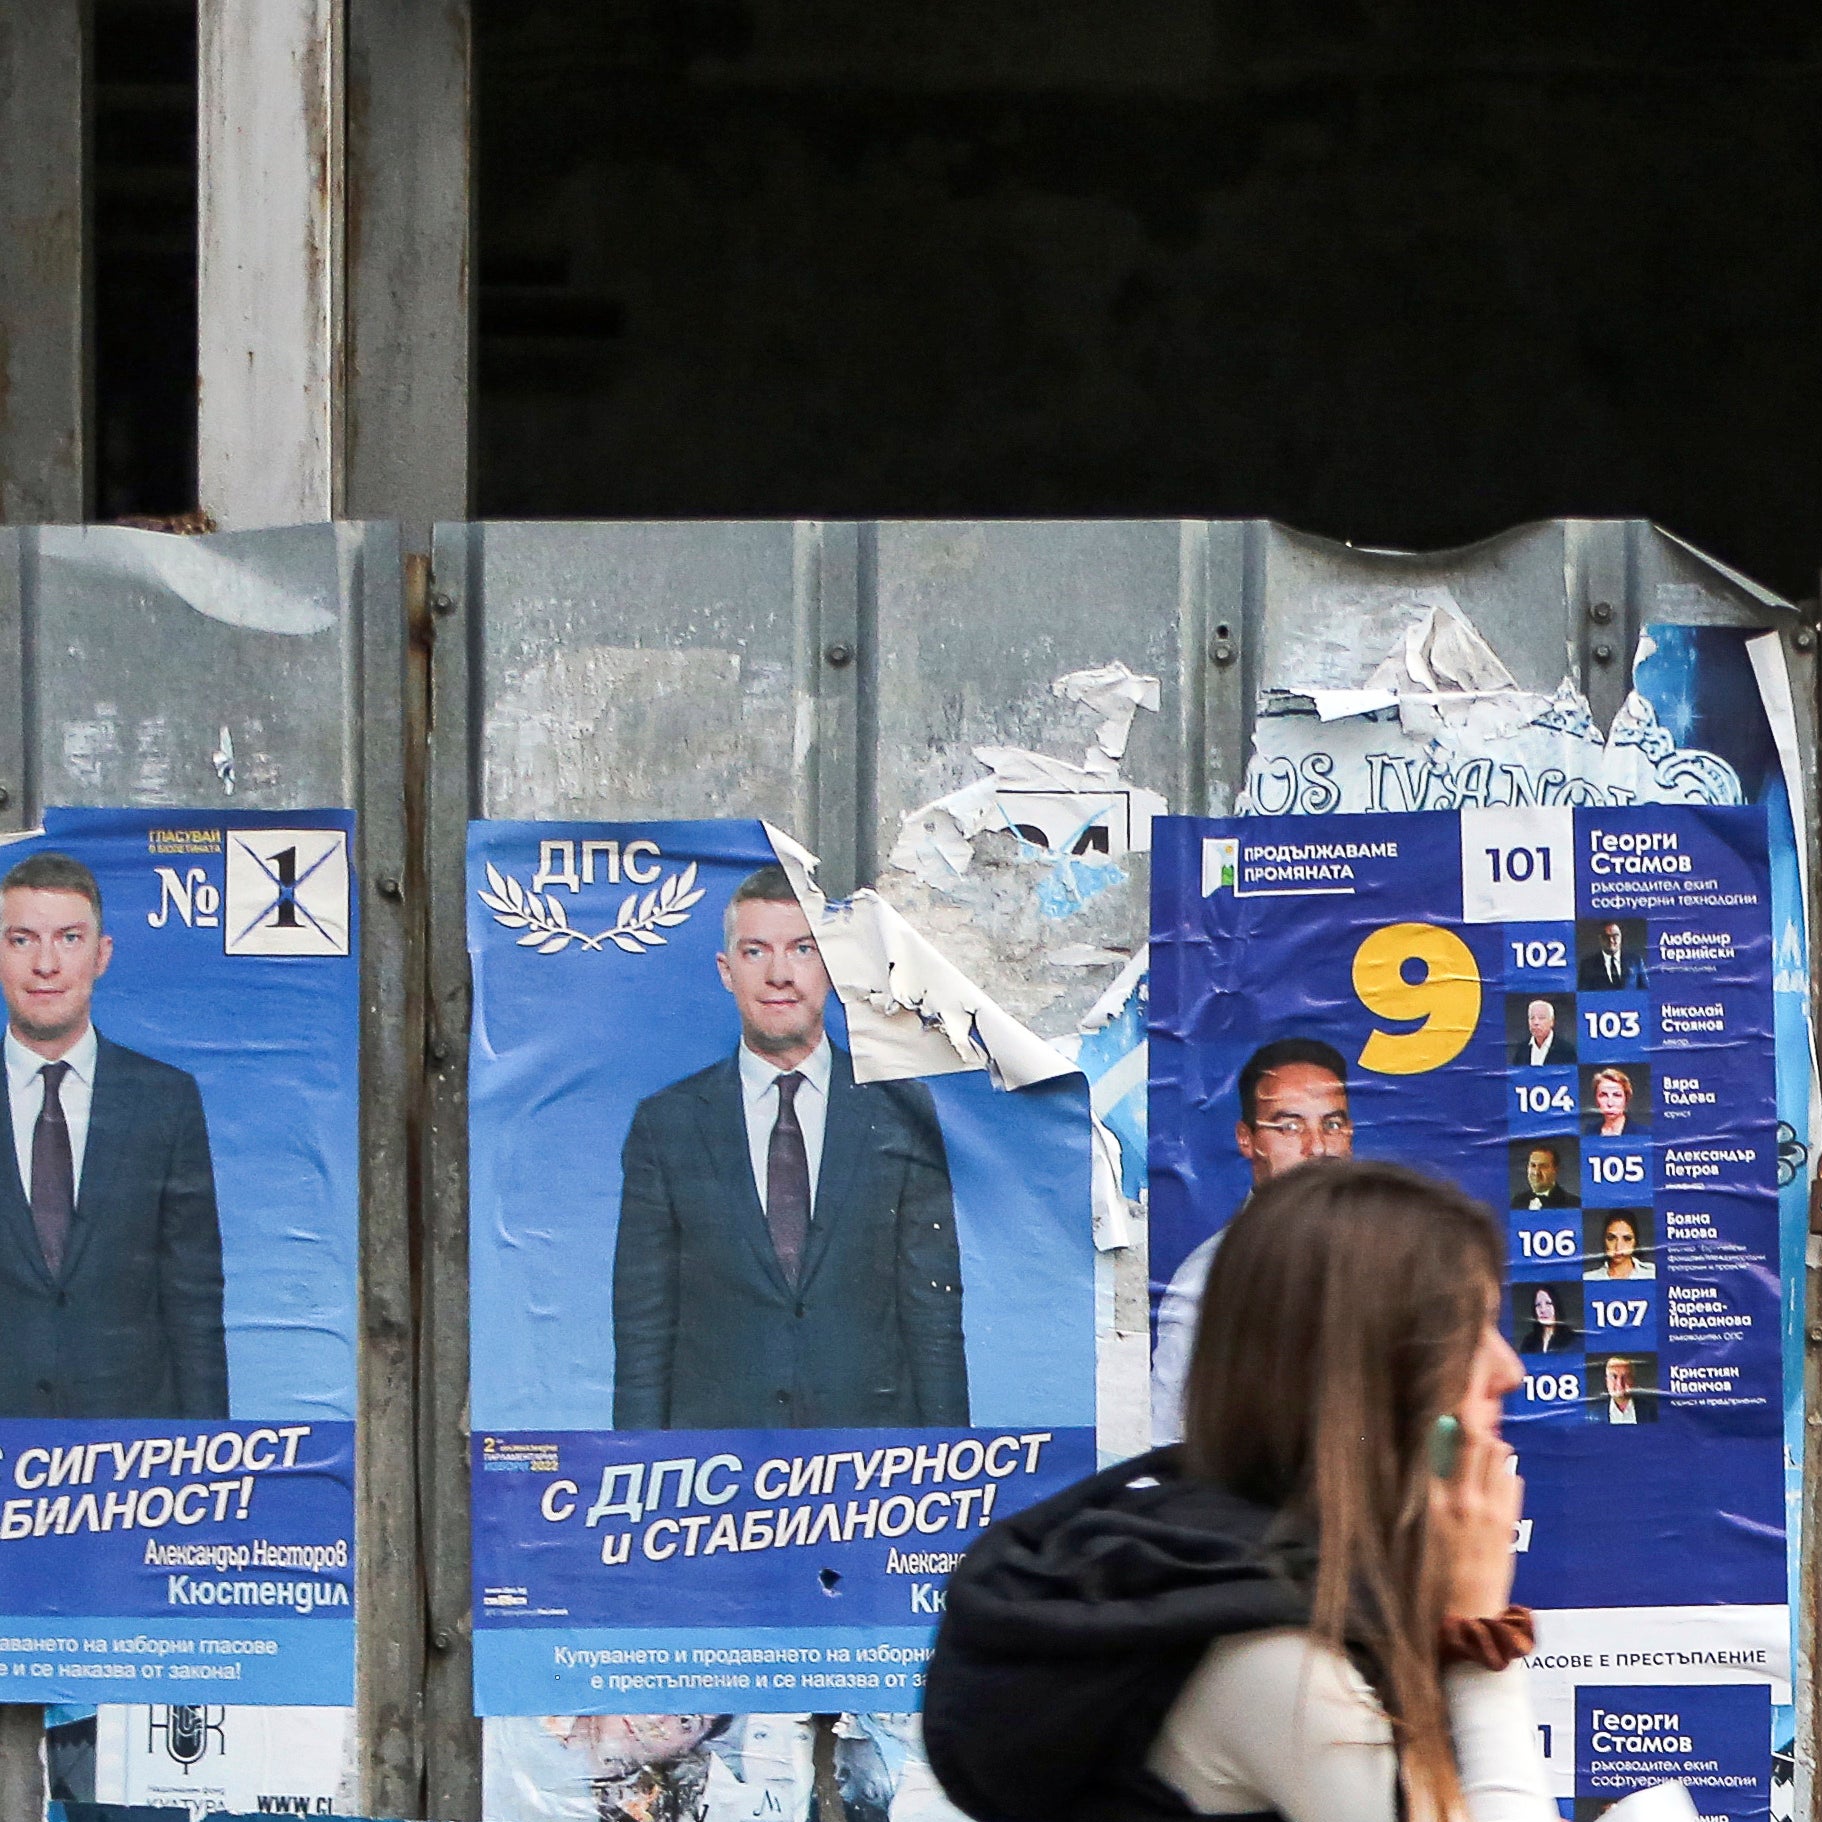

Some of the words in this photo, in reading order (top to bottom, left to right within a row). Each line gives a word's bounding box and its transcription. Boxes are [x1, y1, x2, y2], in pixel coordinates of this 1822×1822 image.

[1244, 841, 1398, 862] ПРОДЪЛЖАВАМЕ
[1590, 829, 1678, 854] Георги
[534, 839, 664, 887] ДПС
[1244, 864, 1355, 882] ПРОМЯНАТА
[1484, 847, 1553, 883] 101
[1590, 852, 1693, 875] Стамов
[147, 866, 220, 928] №
[265, 846, 306, 927] 1
[1590, 878, 1678, 895] ръководител
[1682, 877, 1718, 894] екип
[1590, 894, 1676, 911] софтуерни
[1678, 892, 1758, 907] технологии
[1659, 930, 1731, 948] Любомир
[1512, 940, 1567, 969] 102
[1660, 944, 1736, 960] Терзийски
[1350, 921, 1481, 1075] 9
[1660, 1003, 1724, 1019] Николай
[1584, 1011, 1641, 1040] 103
[1660, 1016, 1724, 1033] Стоянов
[1662, 1076, 1700, 1093] Вяра
[1514, 1085, 1575, 1112] 104
[1662, 1088, 1716, 1105] Тодева
[1664, 1147, 1756, 1164] Александър
[1588, 1156, 1645, 1182] 105
[1664, 1160, 1720, 1177] Петров
[1666, 1211, 1711, 1228] Бояна
[1518, 1230, 1576, 1256] 106
[1666, 1223, 1718, 1241] Ризова
[1667, 1285, 1718, 1301] Мария
[1591, 1301, 1648, 1328] 107
[1670, 1365, 1740, 1380] Кристиян
[1523, 1373, 1580, 1399] 108
[1670, 1377, 1733, 1393] Иванчов
[13, 1426, 311, 1490] СИГУРНОСТ
[540, 1477, 578, 1523] С
[587, 1452, 742, 1529] ДПС
[753, 1432, 1051, 1501] СИГУРНОСТ
[641, 1483, 999, 1563] СТАБИЛНОСТ!
[144, 1539, 249, 1572] Александър
[253, 1539, 348, 1572] Несторов
[167, 1574, 349, 1613] Кюстендил
[554, 1644, 670, 1667] Купуването
[675, 1647, 688, 1662] и
[692, 1646, 824, 1667] продаването
[827, 1646, 850, 1663] на
[1600, 1655, 1610, 1667] Е
[1617, 1650, 1766, 1666] ПРЕСТЪПЛЕНИЕ
[590, 1675, 602, 1689] е
[608, 1673, 750, 1694] престъпление
[755, 1674, 768, 1688] и
[774, 1674, 797, 1688] се
[801, 1671, 880, 1689] наказва
[885, 1673, 907, 1688] от
